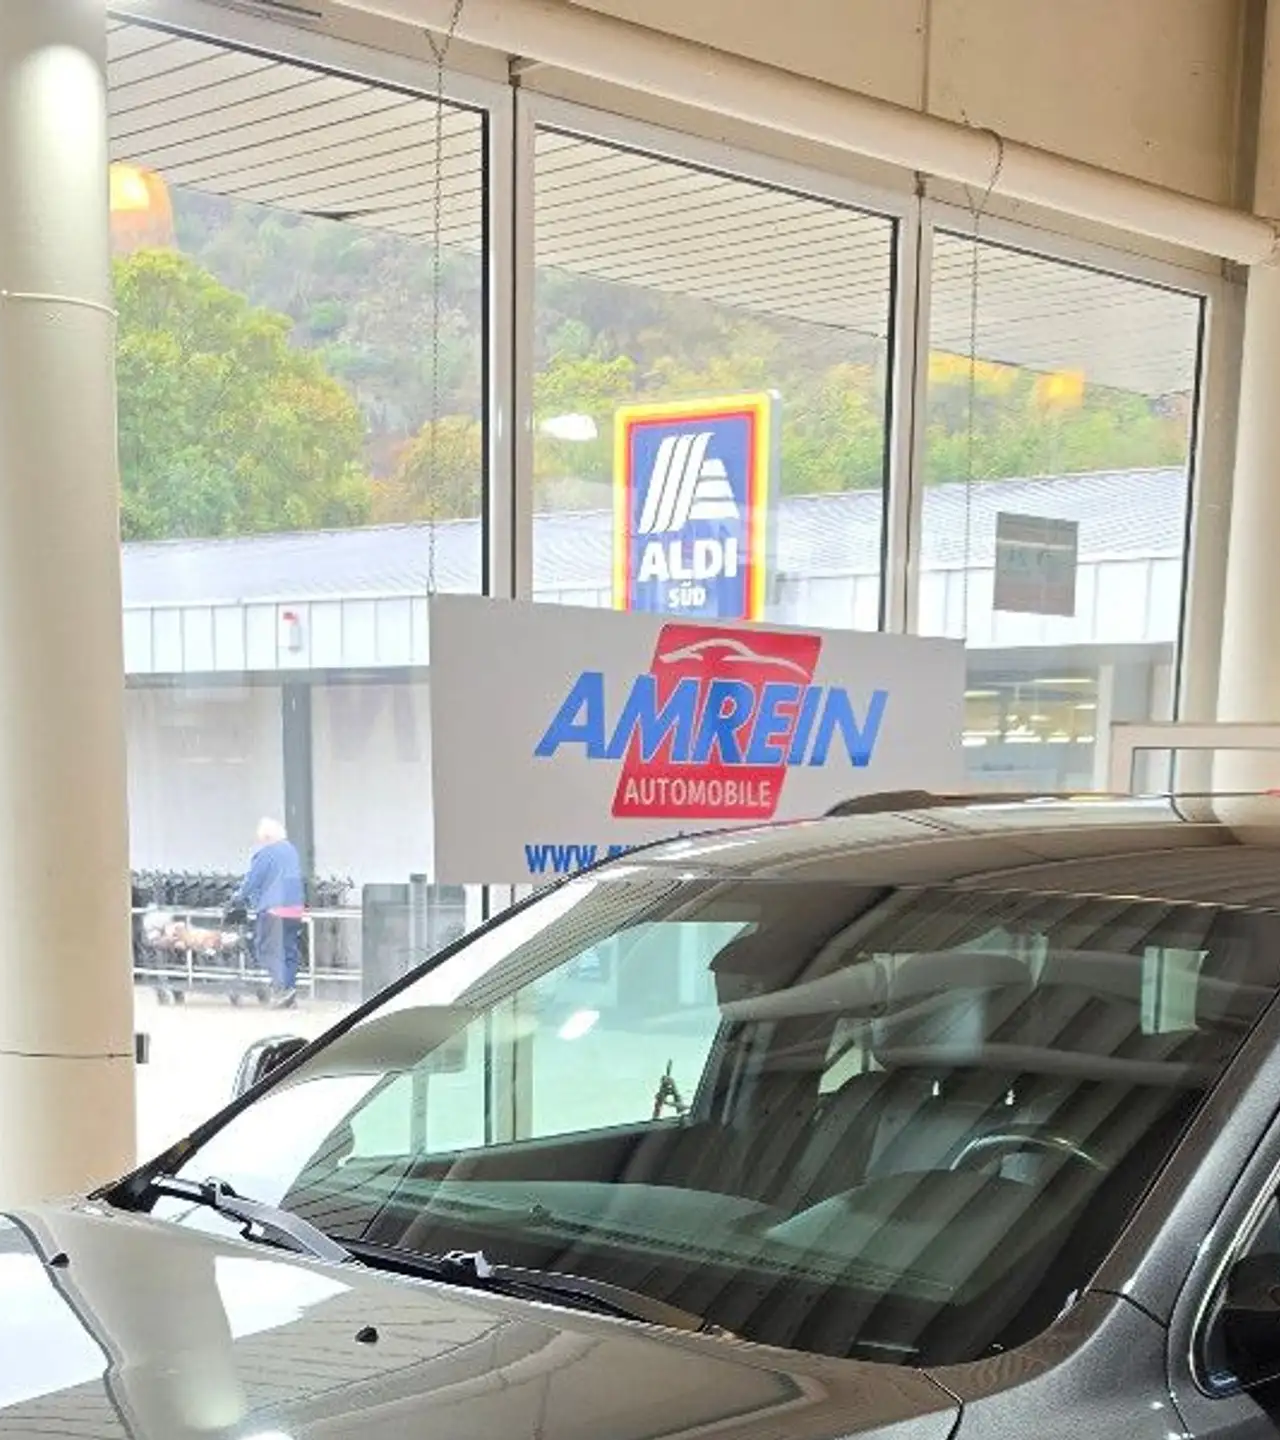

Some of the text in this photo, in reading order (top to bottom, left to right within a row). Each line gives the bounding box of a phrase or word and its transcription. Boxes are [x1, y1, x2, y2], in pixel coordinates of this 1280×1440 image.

[638, 537, 738, 582] ALDI
[668, 580, 706, 608] SÜD
[533, 670, 890, 767] AMREIN
[622, 777, 772, 807] AUTOMOBILE
